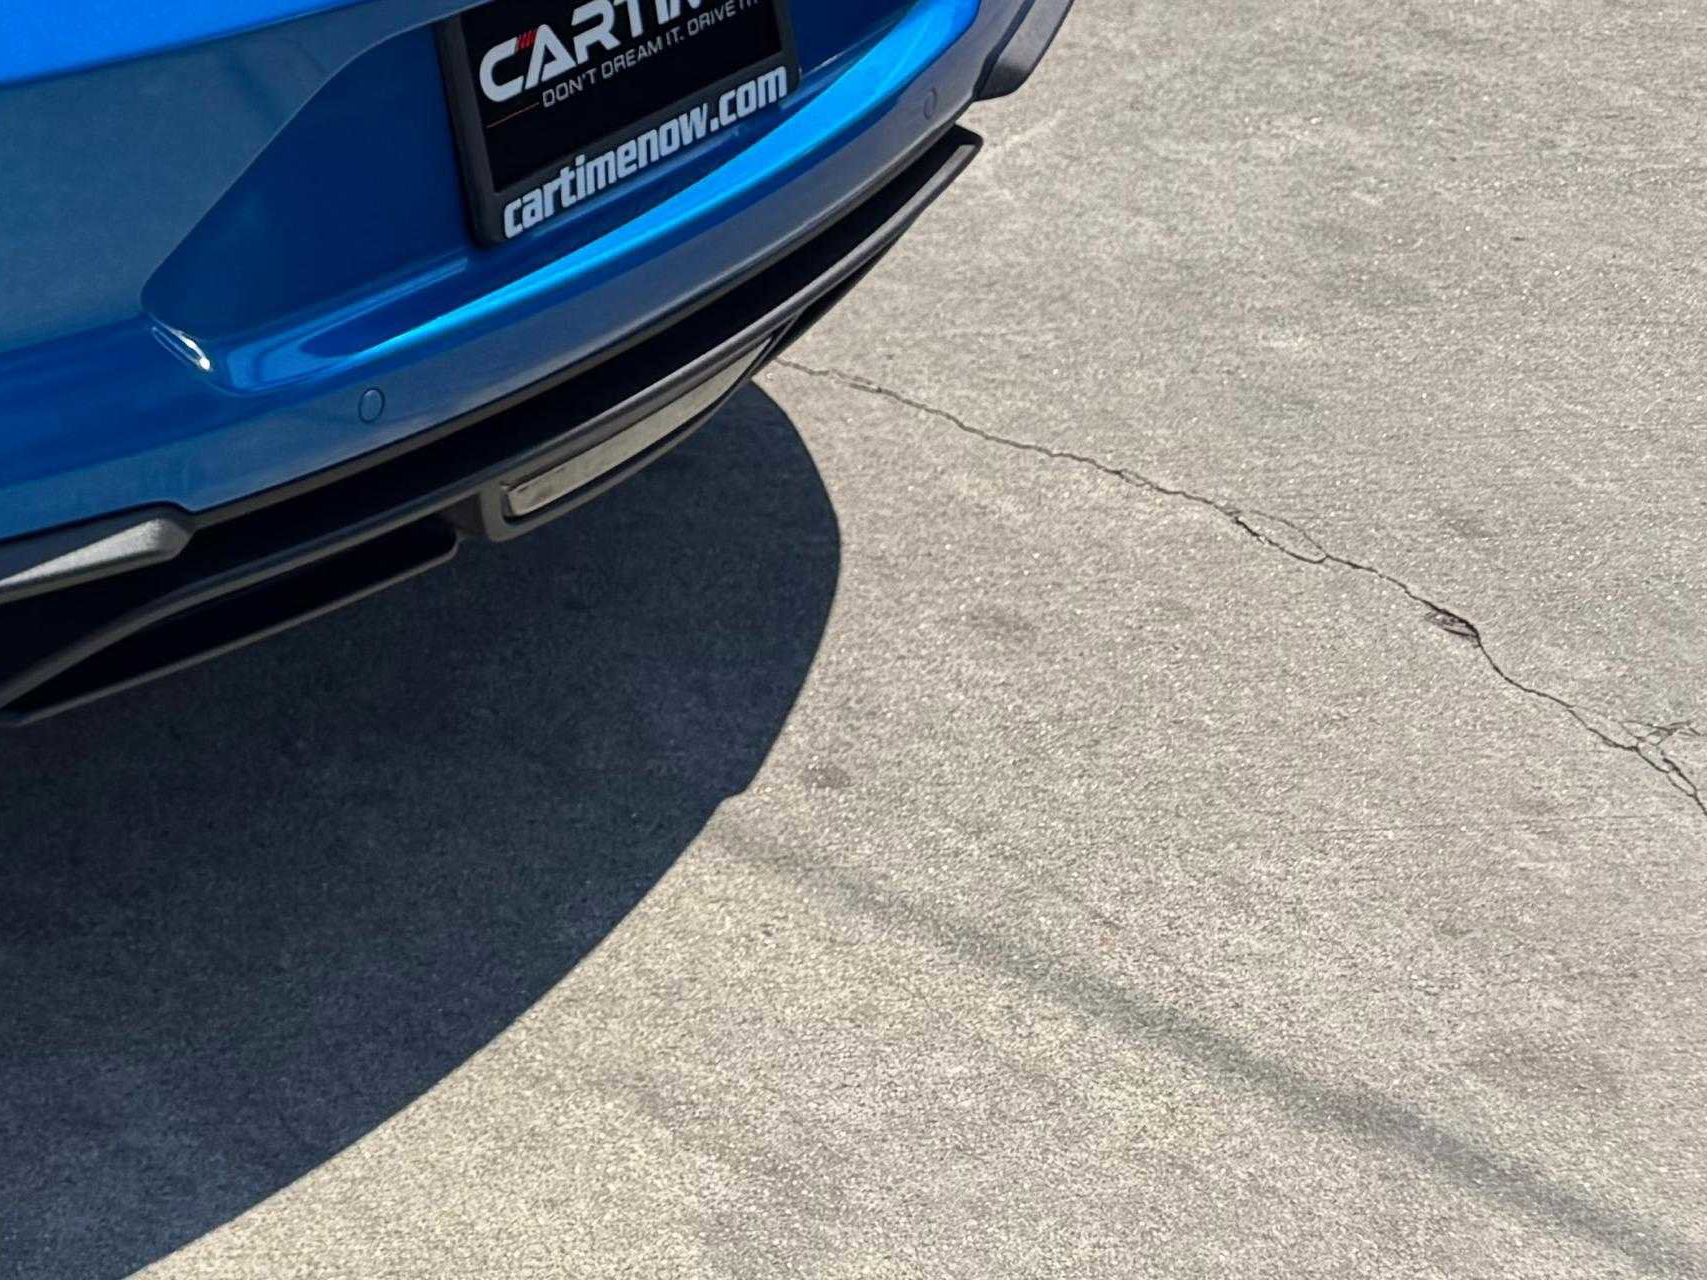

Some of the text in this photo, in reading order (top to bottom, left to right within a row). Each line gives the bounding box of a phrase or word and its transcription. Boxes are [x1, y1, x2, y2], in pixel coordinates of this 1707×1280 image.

[542, 66, 597, 108] DON'T
[601, 36, 663, 79] DREAM
[664, 25, 685, 47] IT.
[686, 0, 737, 37] DRIVE
[503, 65, 788, 240] cartimenow.com
